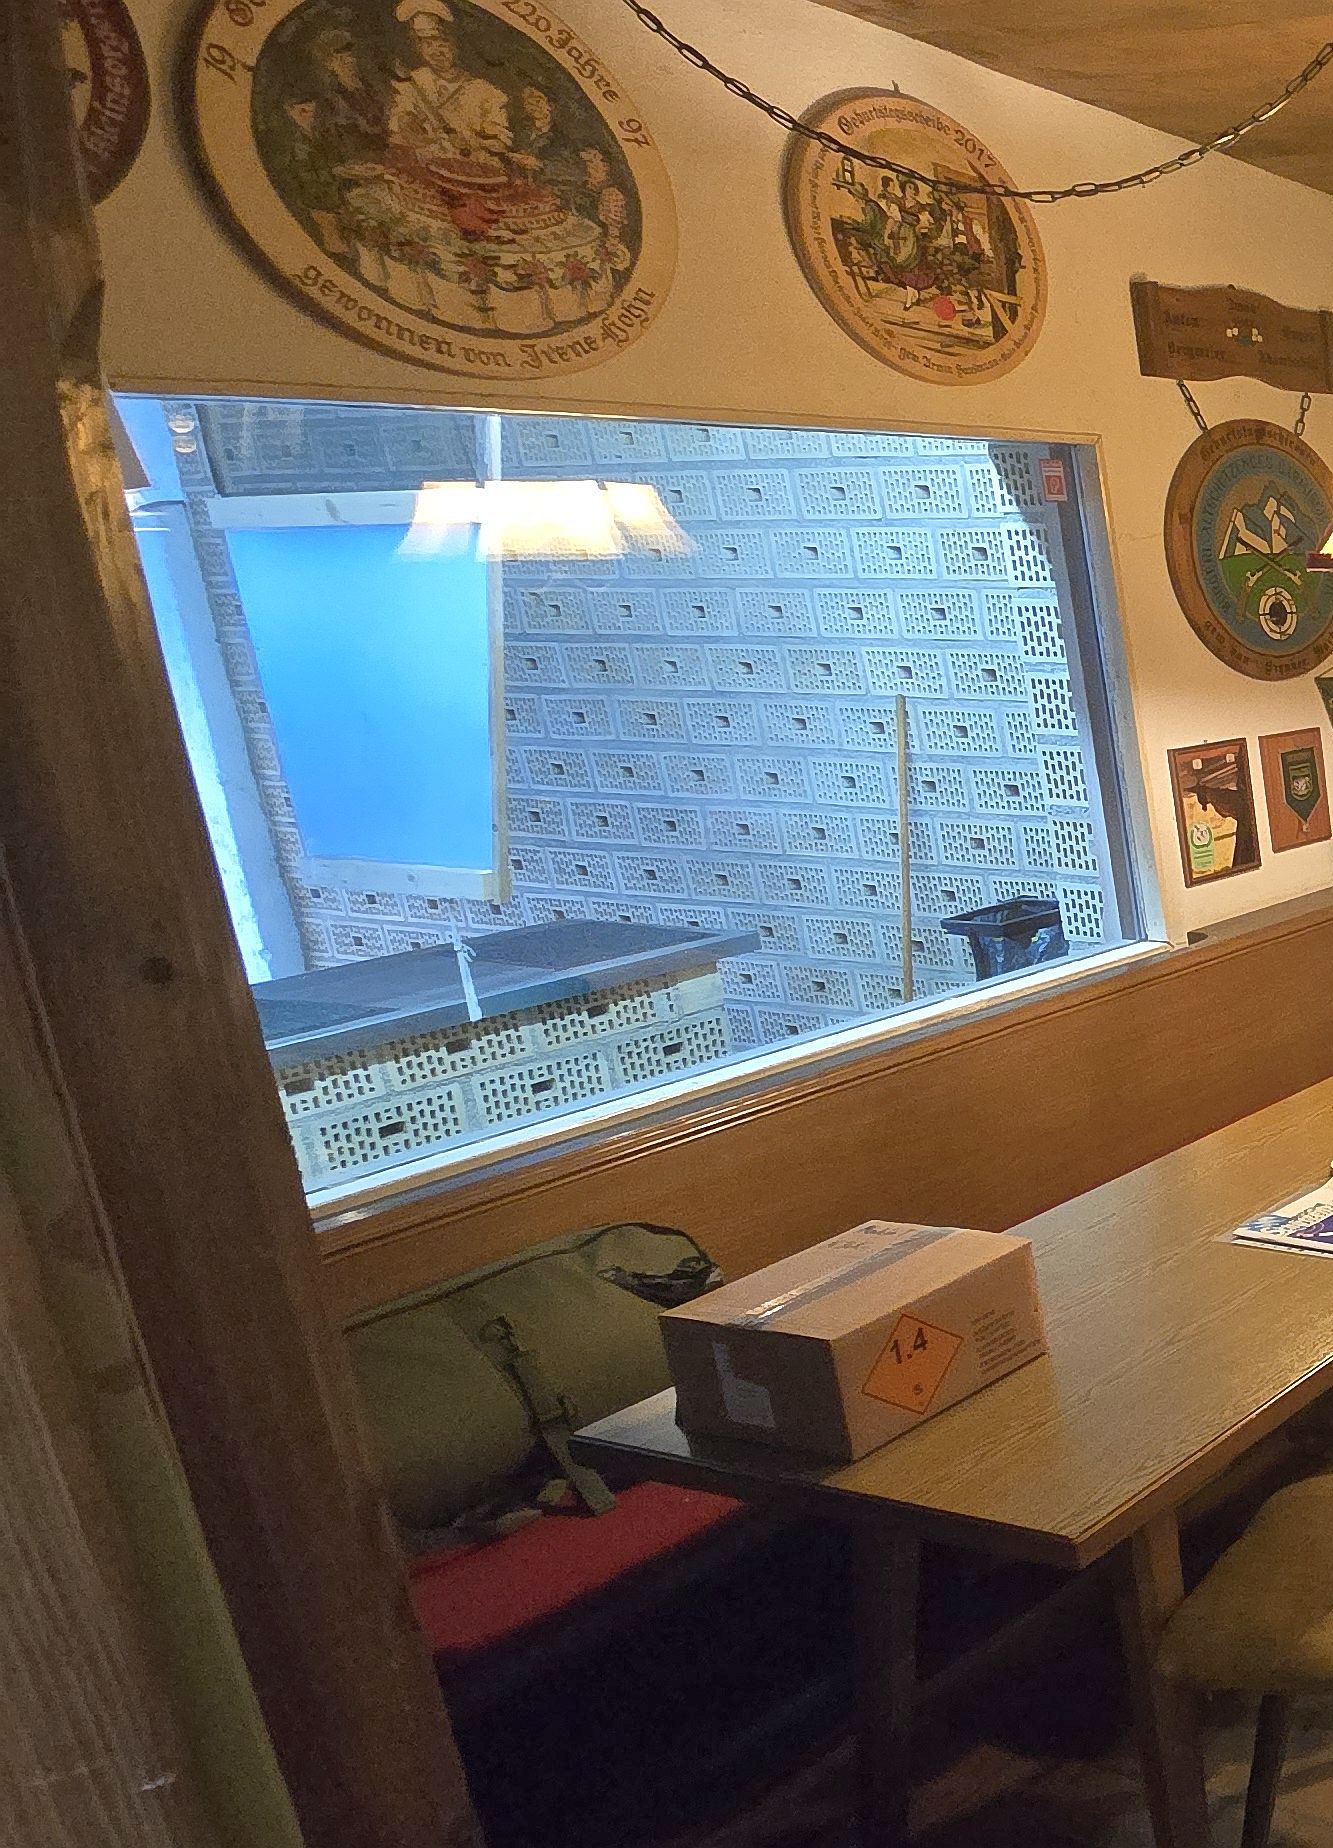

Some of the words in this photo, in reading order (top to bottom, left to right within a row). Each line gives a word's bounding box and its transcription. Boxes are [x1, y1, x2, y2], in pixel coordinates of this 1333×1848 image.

[618, 117, 651, 148] 97
[953, 129, 998, 170] 2017
[298, 264, 457, 359] gewonnen
[459, 346, 512, 368] von
[519, 334, 600, 370] Irene
[889, 1327, 929, 1365] 1.4
